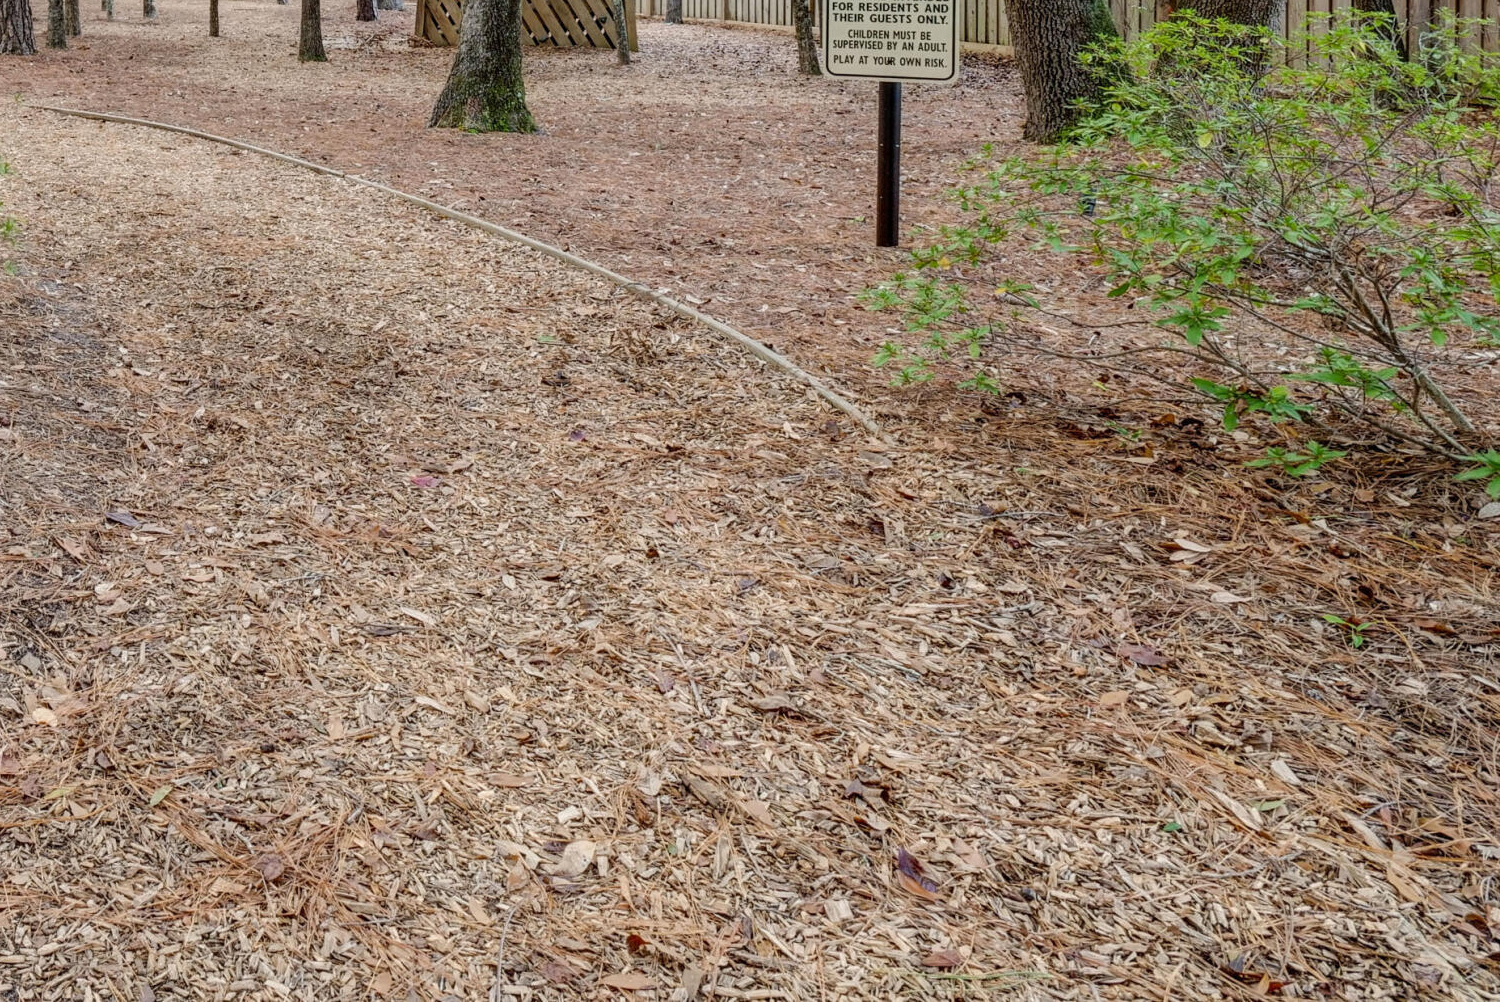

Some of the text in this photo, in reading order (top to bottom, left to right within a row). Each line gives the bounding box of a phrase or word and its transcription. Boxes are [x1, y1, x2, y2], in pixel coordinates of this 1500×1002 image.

[832, 2, 948, 13] FOR RESIDENTS AND
[833, 13, 948, 24] THEIR GUESTS ONLY.
[848, 29, 931, 40] CHILDREN MUST BE
[833, 40, 947, 52] SUPERVISED BY AN ADULT.
[834, 55, 947, 67] PLAY AT YOUR OWN RISK.
